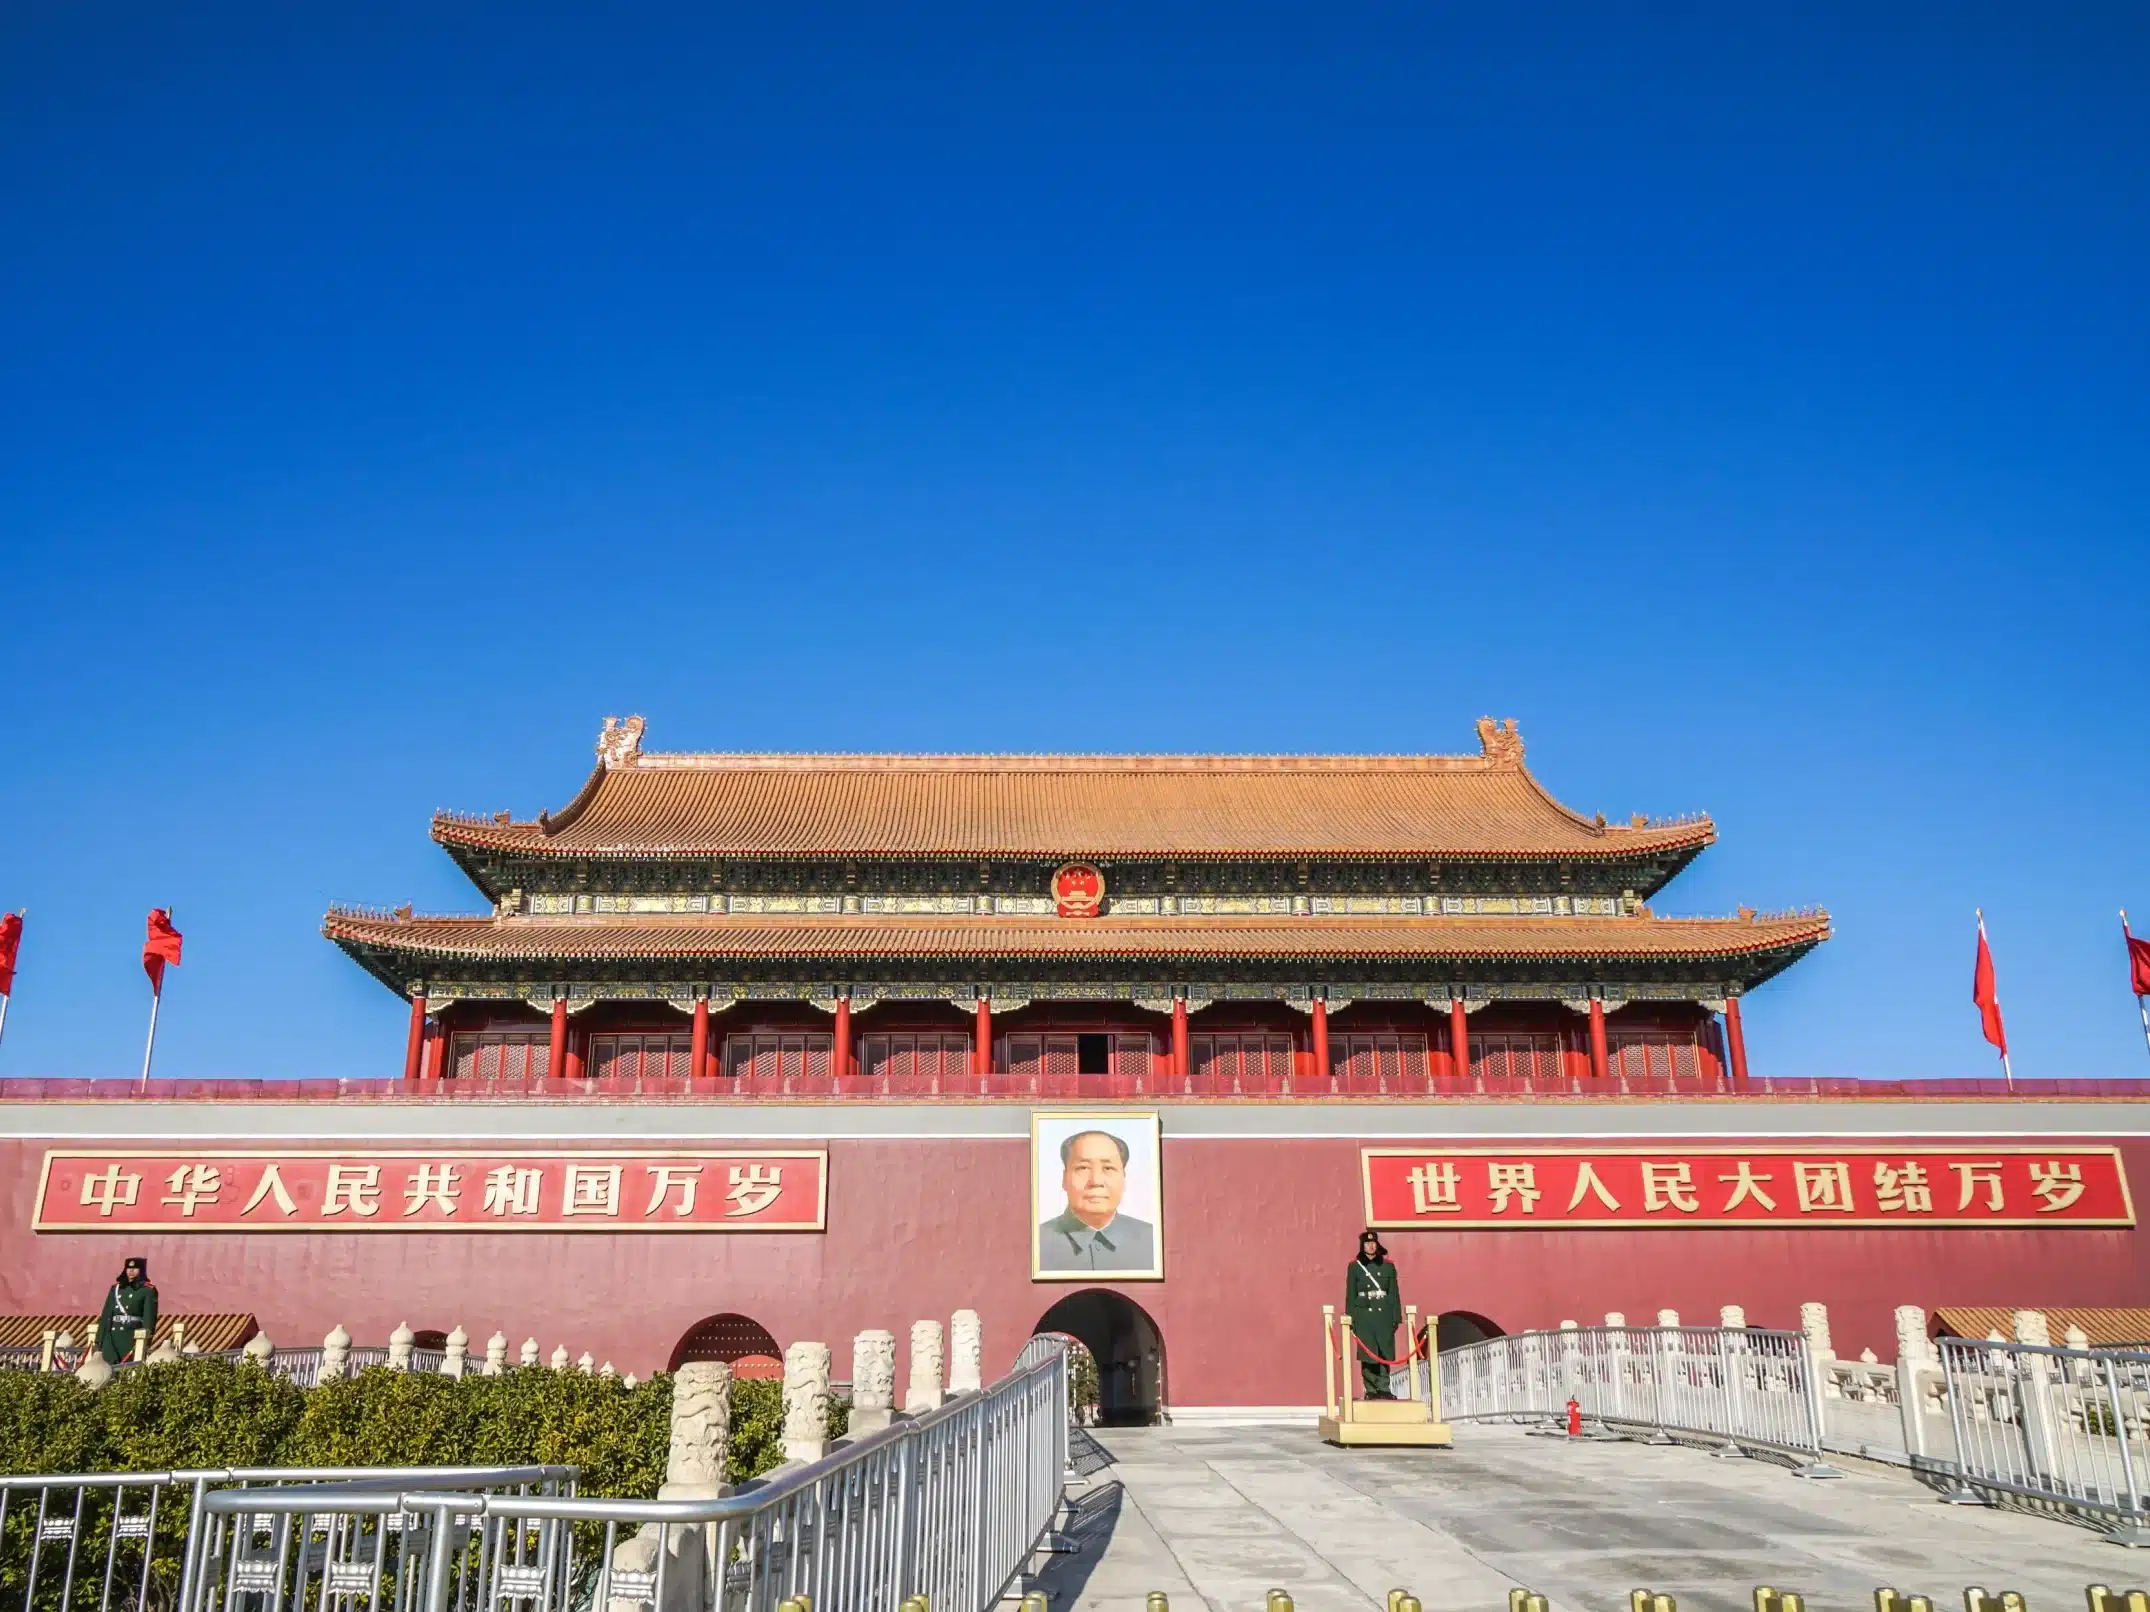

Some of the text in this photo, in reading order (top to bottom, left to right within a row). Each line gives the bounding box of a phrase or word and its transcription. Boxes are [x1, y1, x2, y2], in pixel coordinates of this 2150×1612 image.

[80, 1164, 785, 1217] 中华人民共和国万岁
[1406, 1161, 2086, 1214] 世界人民大团结万岁
